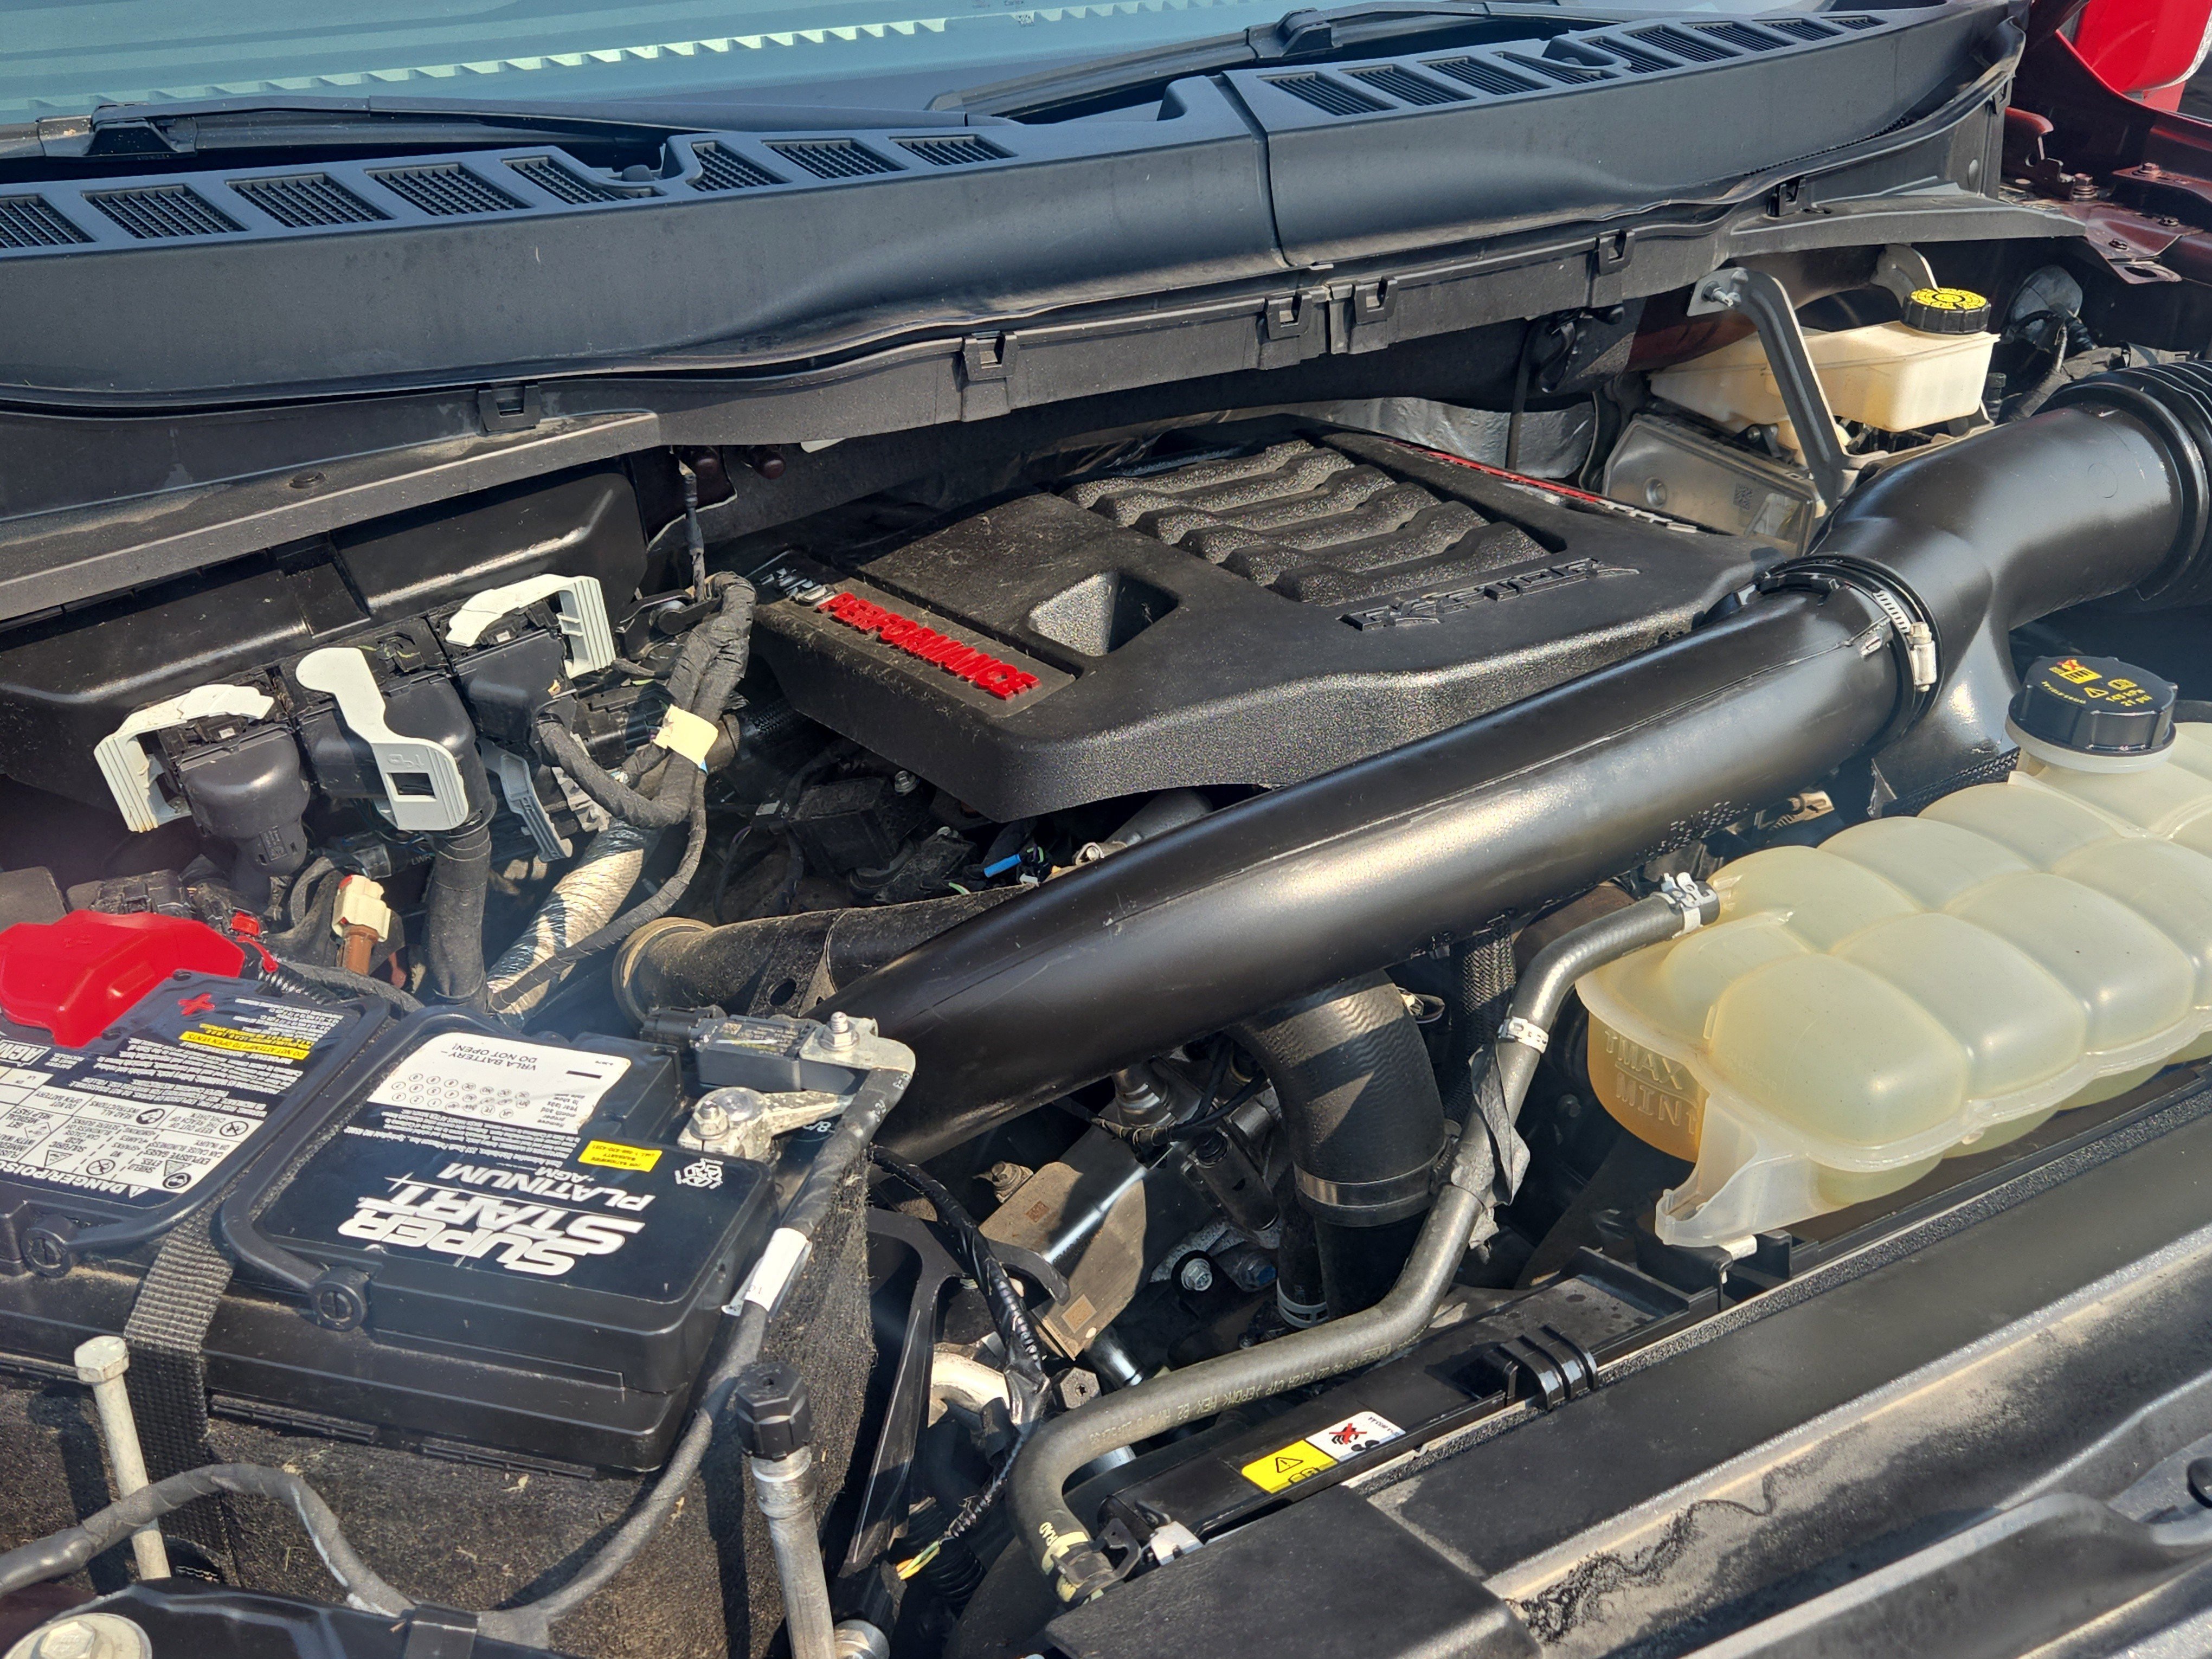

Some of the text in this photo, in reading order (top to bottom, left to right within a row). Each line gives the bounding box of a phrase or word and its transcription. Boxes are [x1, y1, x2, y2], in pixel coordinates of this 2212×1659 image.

[815, 592, 1042, 700] PERFORMANCE
[209, 1038, 234, 1046] OPEN
[241, 1043, 277, 1053] ATTEMPT
[273, 1048, 294, 1056] NOT
[447, 1051, 504, 1065] BATTERY
[450, 1043, 538, 1063] DO NOT OPEN!
[504, 1060, 538, 1071] VRLA
[1618, 1036, 1683, 1090] MAX
[1616, 1072, 1680, 1127] MIN
[5, 1114, 40, 1124] MEDICAL
[535, 1118, 565, 1127] Remove
[47, 1141, 88, 1153] SULFURIC
[64, 1136, 86, 1144] ACID
[142, 1148, 213, 1165] EXPLOSIVE GASES
[126, 1163, 157, 1173] SHIELD
[436, 1163, 655, 1211] PLATINUM
[358, 1185, 645, 1255] START
[338, 1208, 587, 1276] SUPER
[1039, 1521, 1058, 1547] RAD
